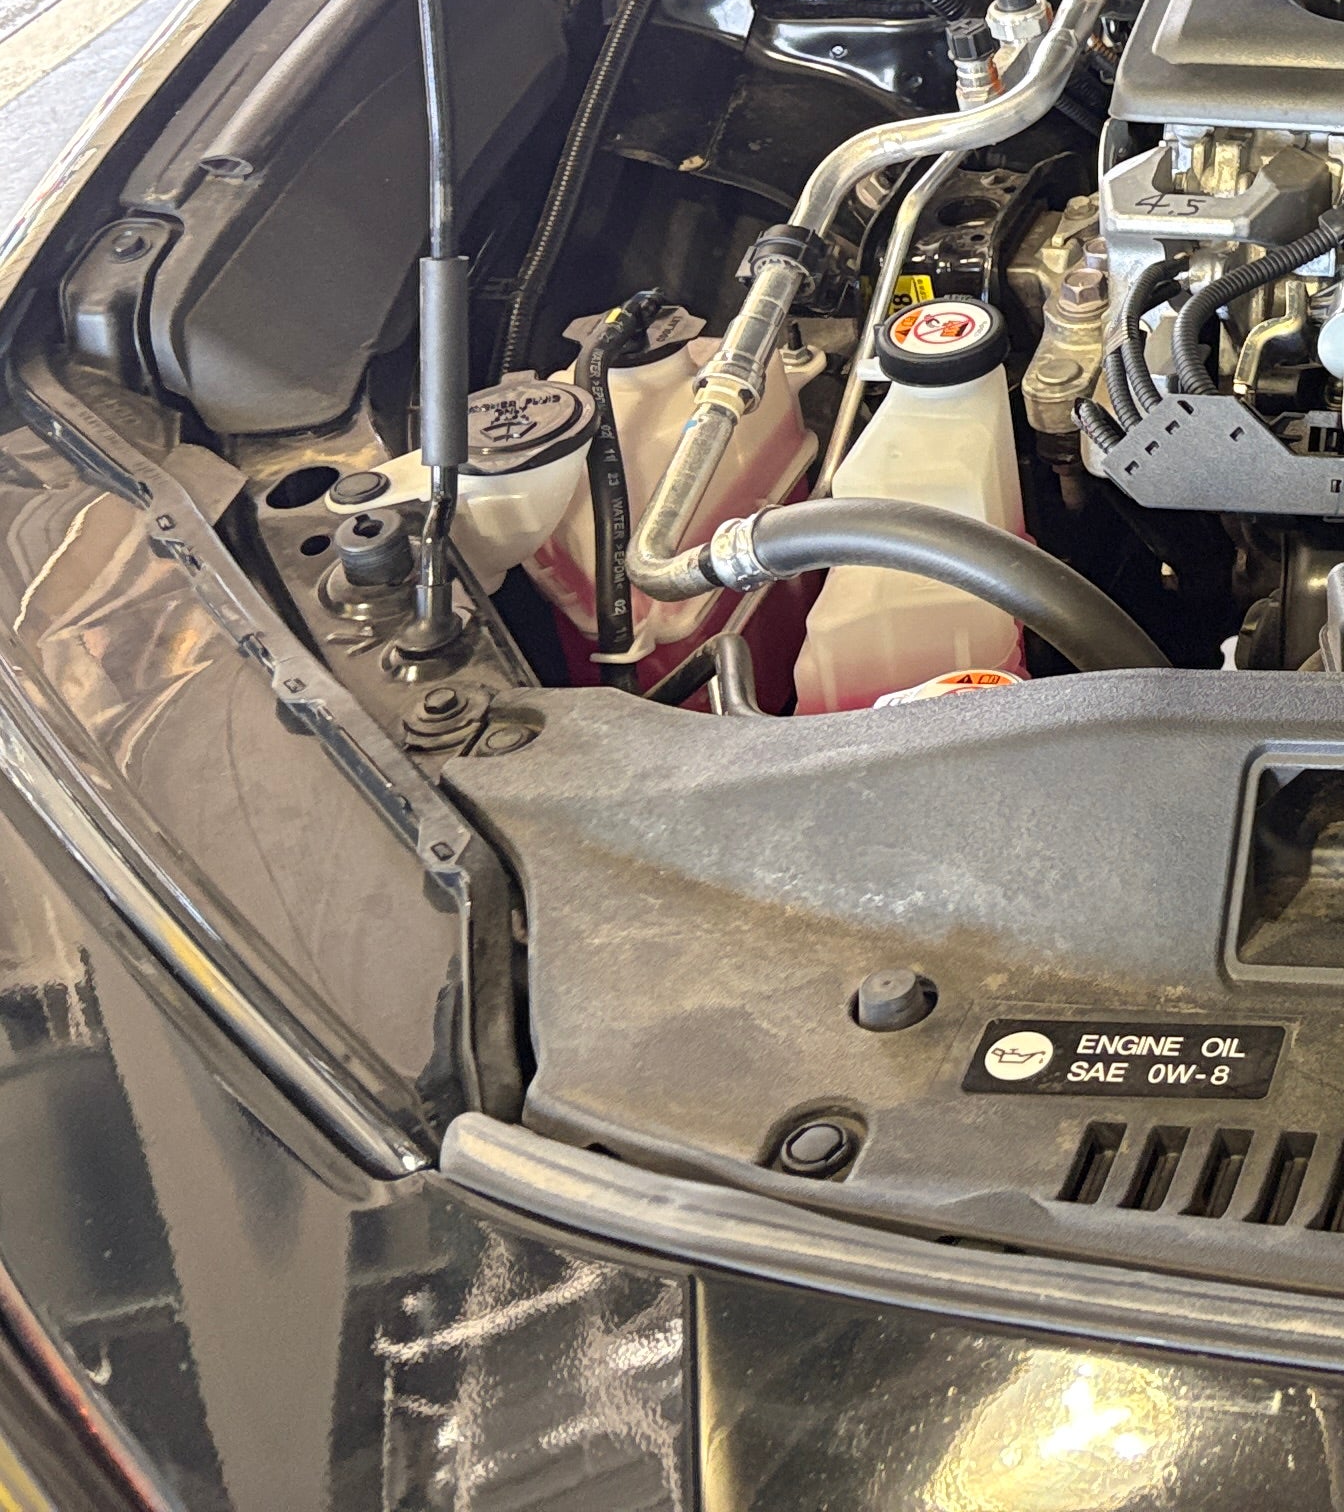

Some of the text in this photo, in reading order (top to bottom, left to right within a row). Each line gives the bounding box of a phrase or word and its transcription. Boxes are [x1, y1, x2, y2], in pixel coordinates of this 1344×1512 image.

[1135, 193, 1207, 216] 4.5
[612, 496, 627, 540] WATER
[1075, 1034, 1246, 1058] ENGINE OIL
[1066, 1061, 1231, 1086] SAE 0W-8
